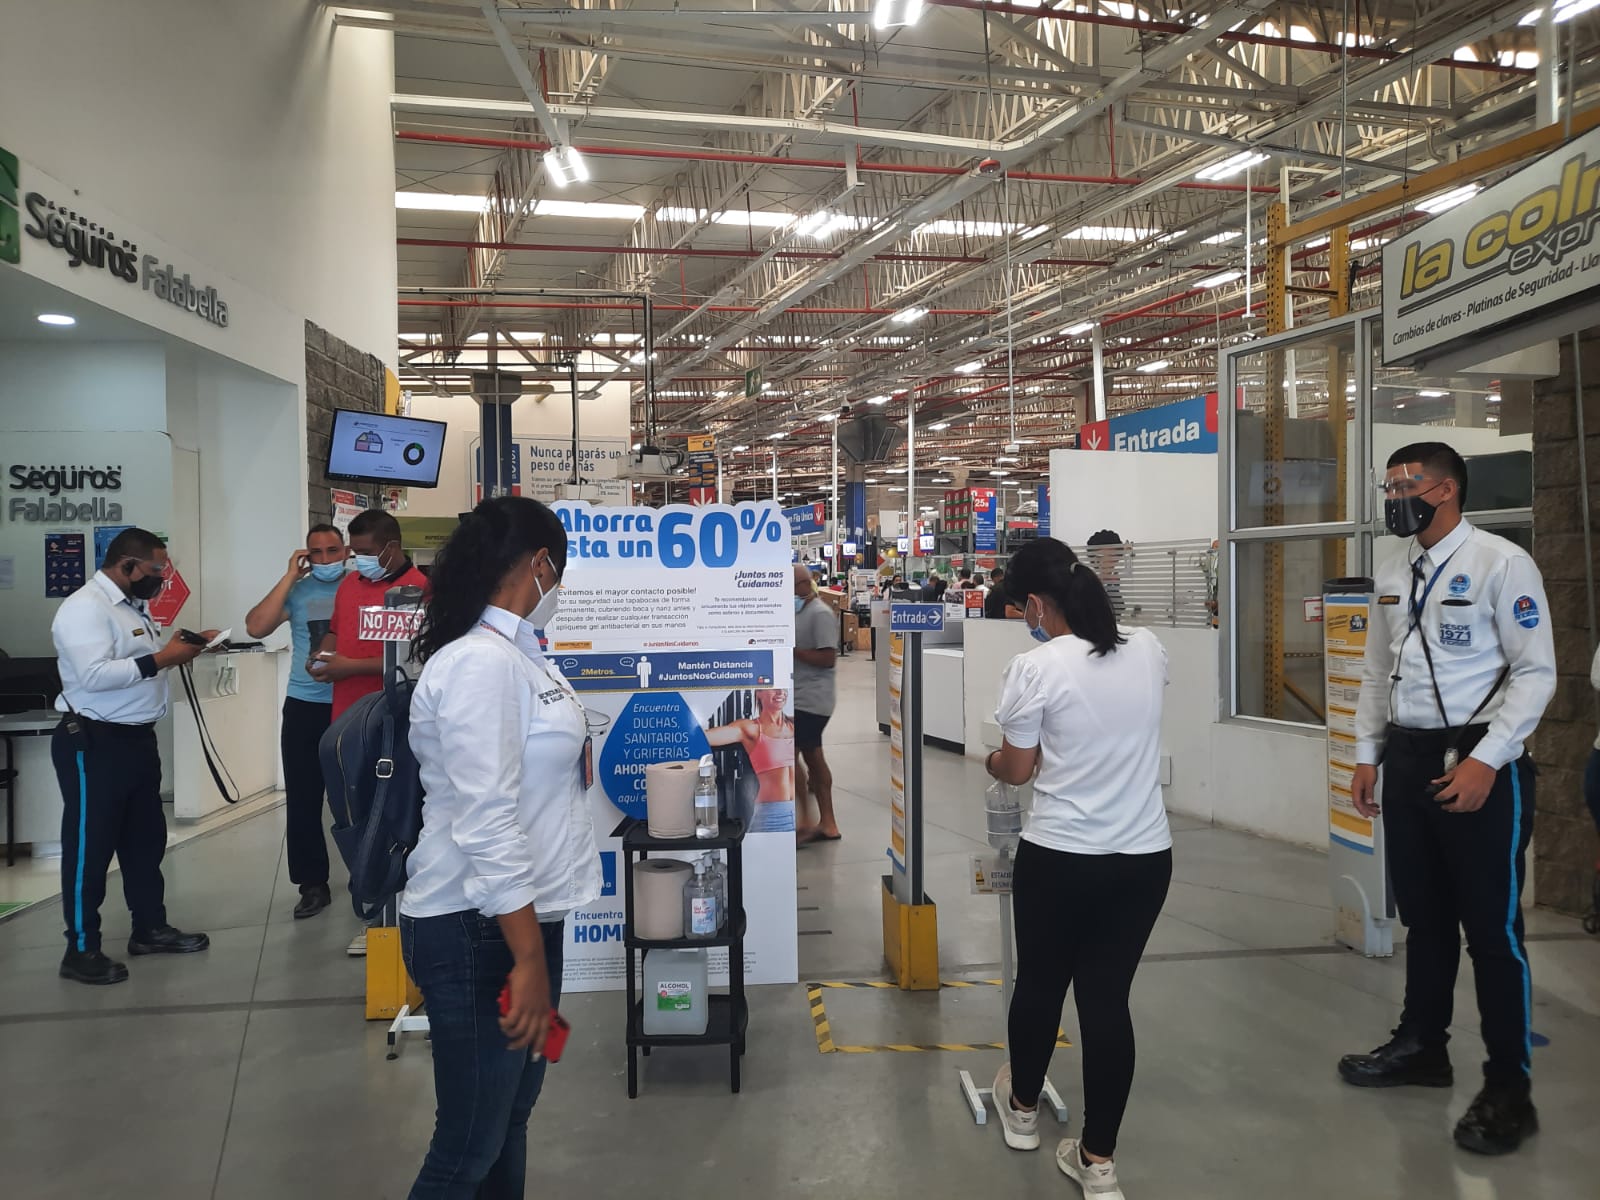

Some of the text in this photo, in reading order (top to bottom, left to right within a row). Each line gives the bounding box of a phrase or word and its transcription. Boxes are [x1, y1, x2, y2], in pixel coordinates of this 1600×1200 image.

[122, 239, 137, 252] DE
[25, 191, 229, 328] Seguros Falabella
[1401, 238, 1454, 300] la
[1392, 326, 1424, 345] Cambios
[1425, 317, 1436, 333] de
[1436, 309, 1462, 329] claves
[1467, 296, 1504, 316] Platinas
[1504, 286, 1518, 302] de
[1518, 260, 1574, 297] Seguridad
[1114, 418, 1200, 452] Entrada
[530, 445, 563, 458] Nunca
[566, 447, 606, 462] pgarás
[530, 460, 555, 474] peso
[558, 459, 571, 472] de
[9, 464, 122, 497] Seguros
[9, 496, 123, 522] Falabella
[555, 508, 782, 569] Ahorra 60%
[617, 539, 653, 558] un
[734, 570, 784, 581] ¡Juntos nos
[737, 579, 783, 588] Cuidamos!
[604, 589, 628, 597] mayor
[630, 588, 665, 596] contacto
[666, 587, 697, 596] posible!
[363, 613, 383, 629] NO
[891, 610, 927, 624] Entrada
[1440, 629, 1472, 640] 1971
[712, 660, 753, 669] Distancia
[658, 671, 754, 681] #JuntosNosCuidamos
[633, 703, 680, 713] Encuentra
[633, 717, 681, 729] DUCHAS,
[624, 731, 690, 745] SANITARIOS
[623, 746, 691, 760] Y GRIFERÍAS
[613, 763, 649, 776] AHOR
[574, 910, 625, 921] Encuentra
